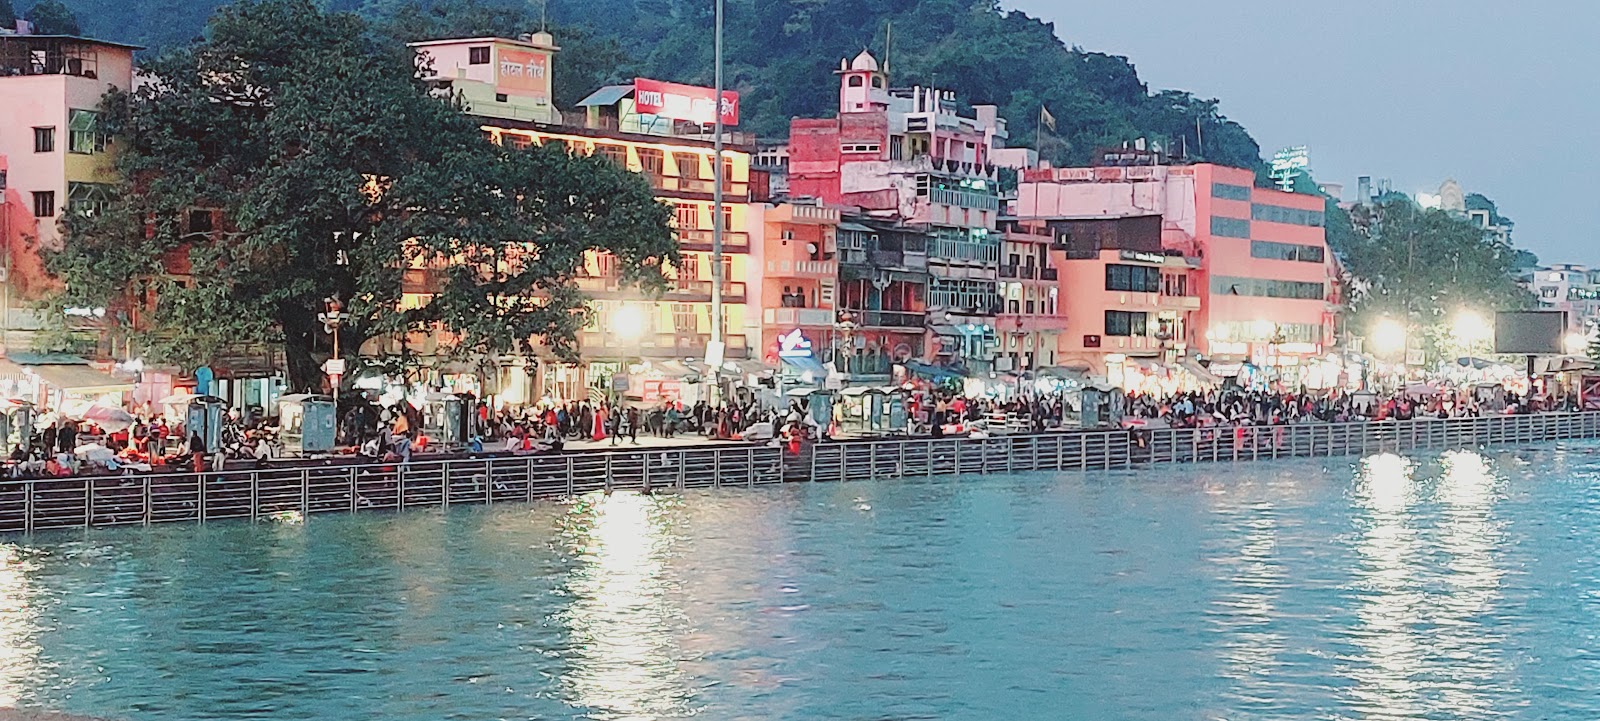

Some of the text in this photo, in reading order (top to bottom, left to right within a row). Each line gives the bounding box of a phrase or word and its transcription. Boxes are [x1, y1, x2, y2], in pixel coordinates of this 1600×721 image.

[500, 56, 544, 80] होटल तीर्थ
[638, 90, 664, 108] HOTEL
